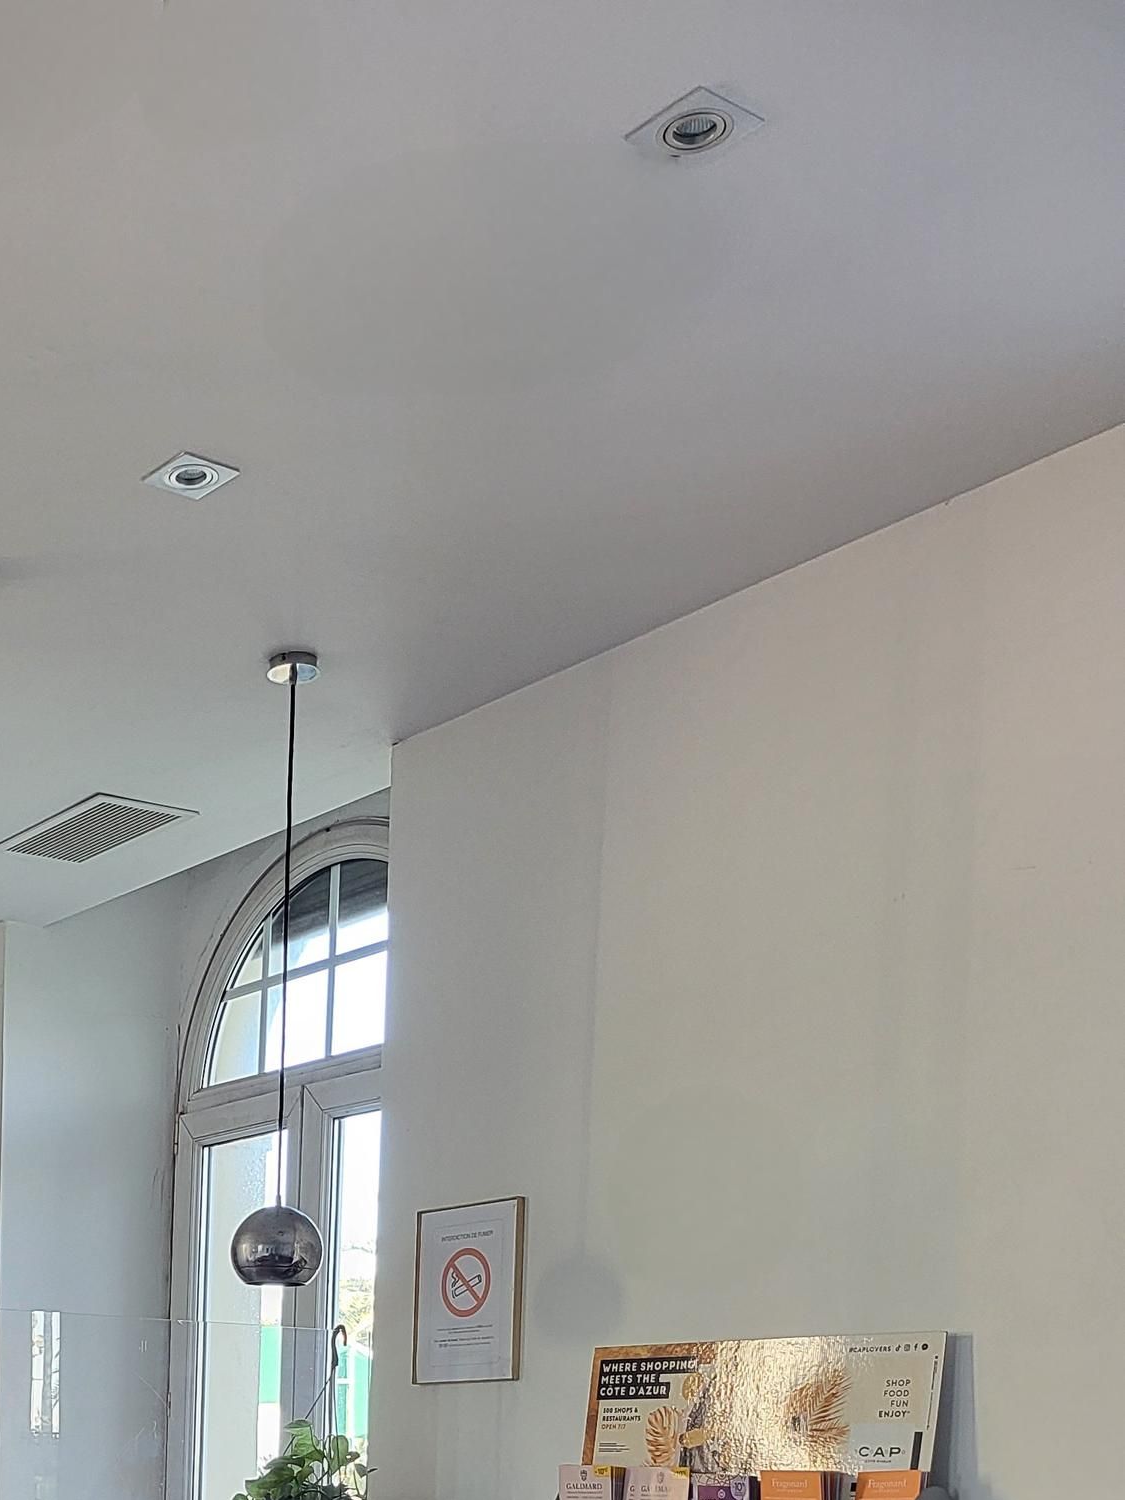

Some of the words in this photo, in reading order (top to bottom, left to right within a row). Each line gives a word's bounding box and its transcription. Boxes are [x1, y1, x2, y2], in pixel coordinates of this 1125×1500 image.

[478, 1230, 494, 1238] FUMER
[602, 1362, 637, 1373] WHERE
[640, 1360, 696, 1371] SHOPPING
[601, 1374, 633, 1384] MEETS
[637, 1373, 656, 1384] THE
[886, 1379, 911, 1387] SHOP
[599, 1385, 626, 1396] CÔTE
[629, 1384, 667, 1396] D'AZUR
[883, 1389, 910, 1397] FOOD
[772, 1479, 808, 1490] Fragonard
[868, 1479, 907, 1490] Fragonard
